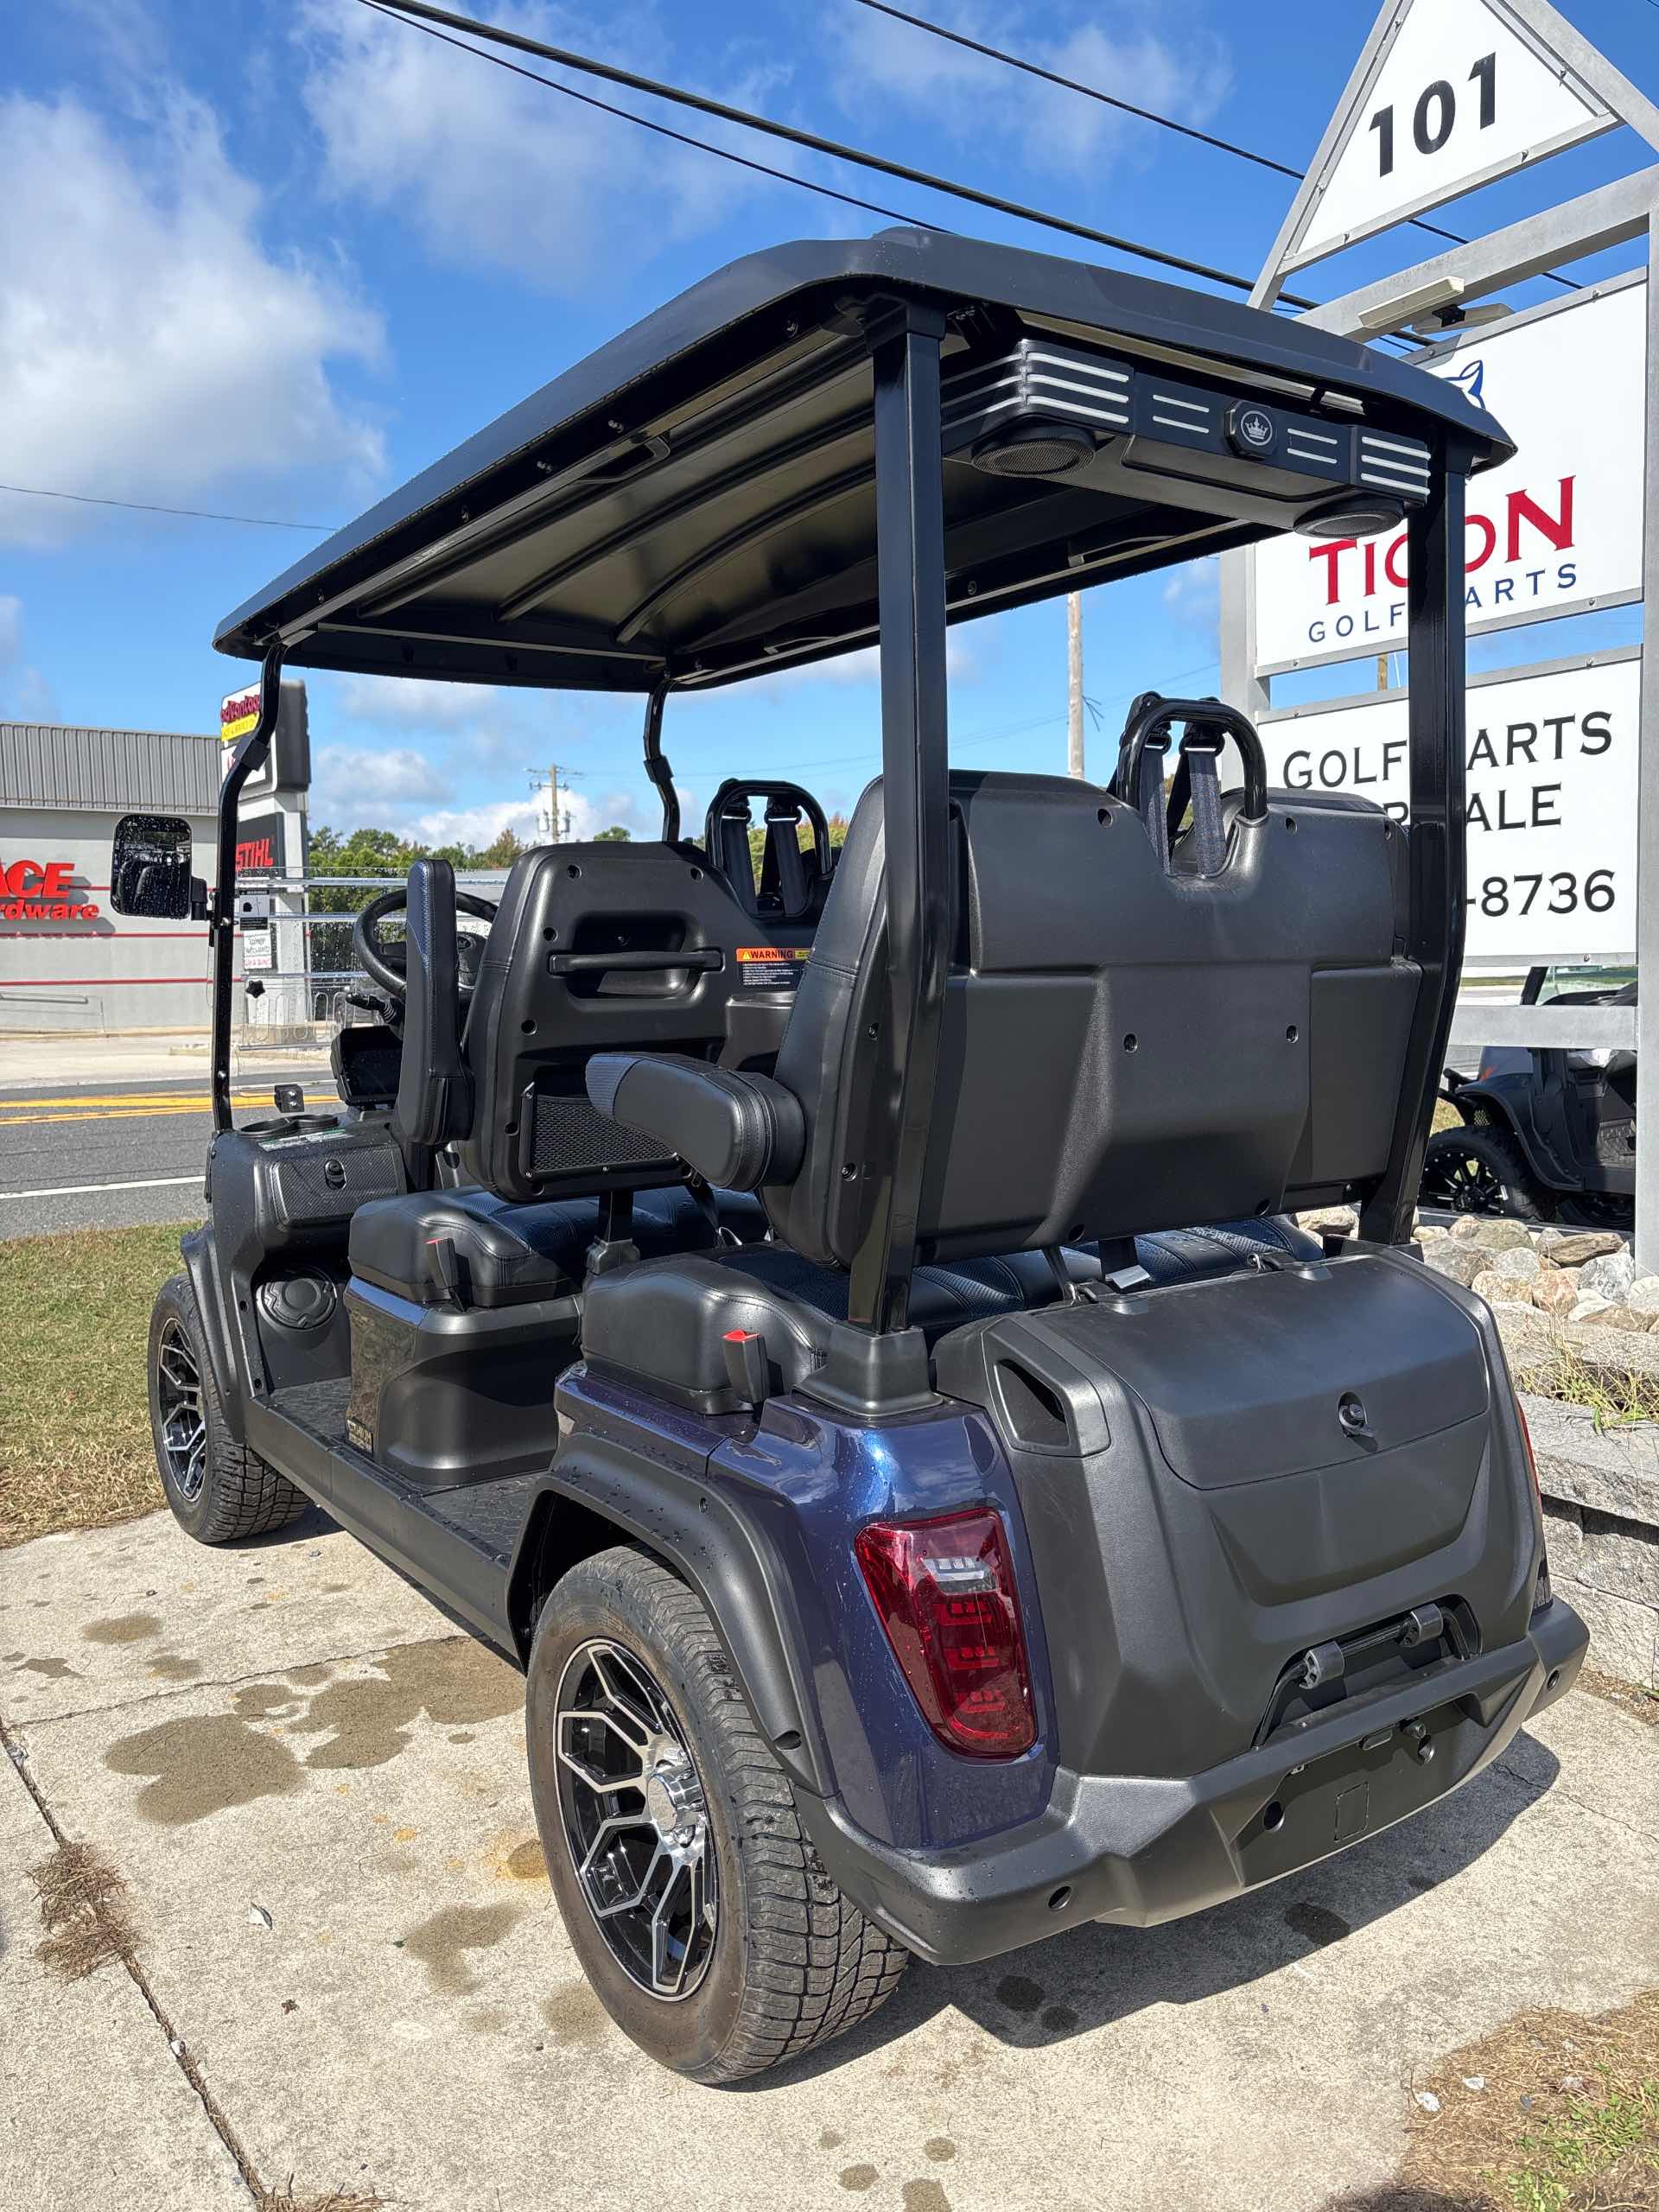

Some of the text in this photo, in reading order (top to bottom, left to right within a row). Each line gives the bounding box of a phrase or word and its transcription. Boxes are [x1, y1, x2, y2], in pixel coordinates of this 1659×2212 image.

[1370, 52, 1497, 178] 101
[1308, 563, 1577, 643] GOLF ARTS
[1283, 710, 1613, 789] GOLF ARTS
[1466, 781, 1562, 831] ALE
[235, 837, 274, 872] STIHL
[750, 950, 794, 959] WARNING
